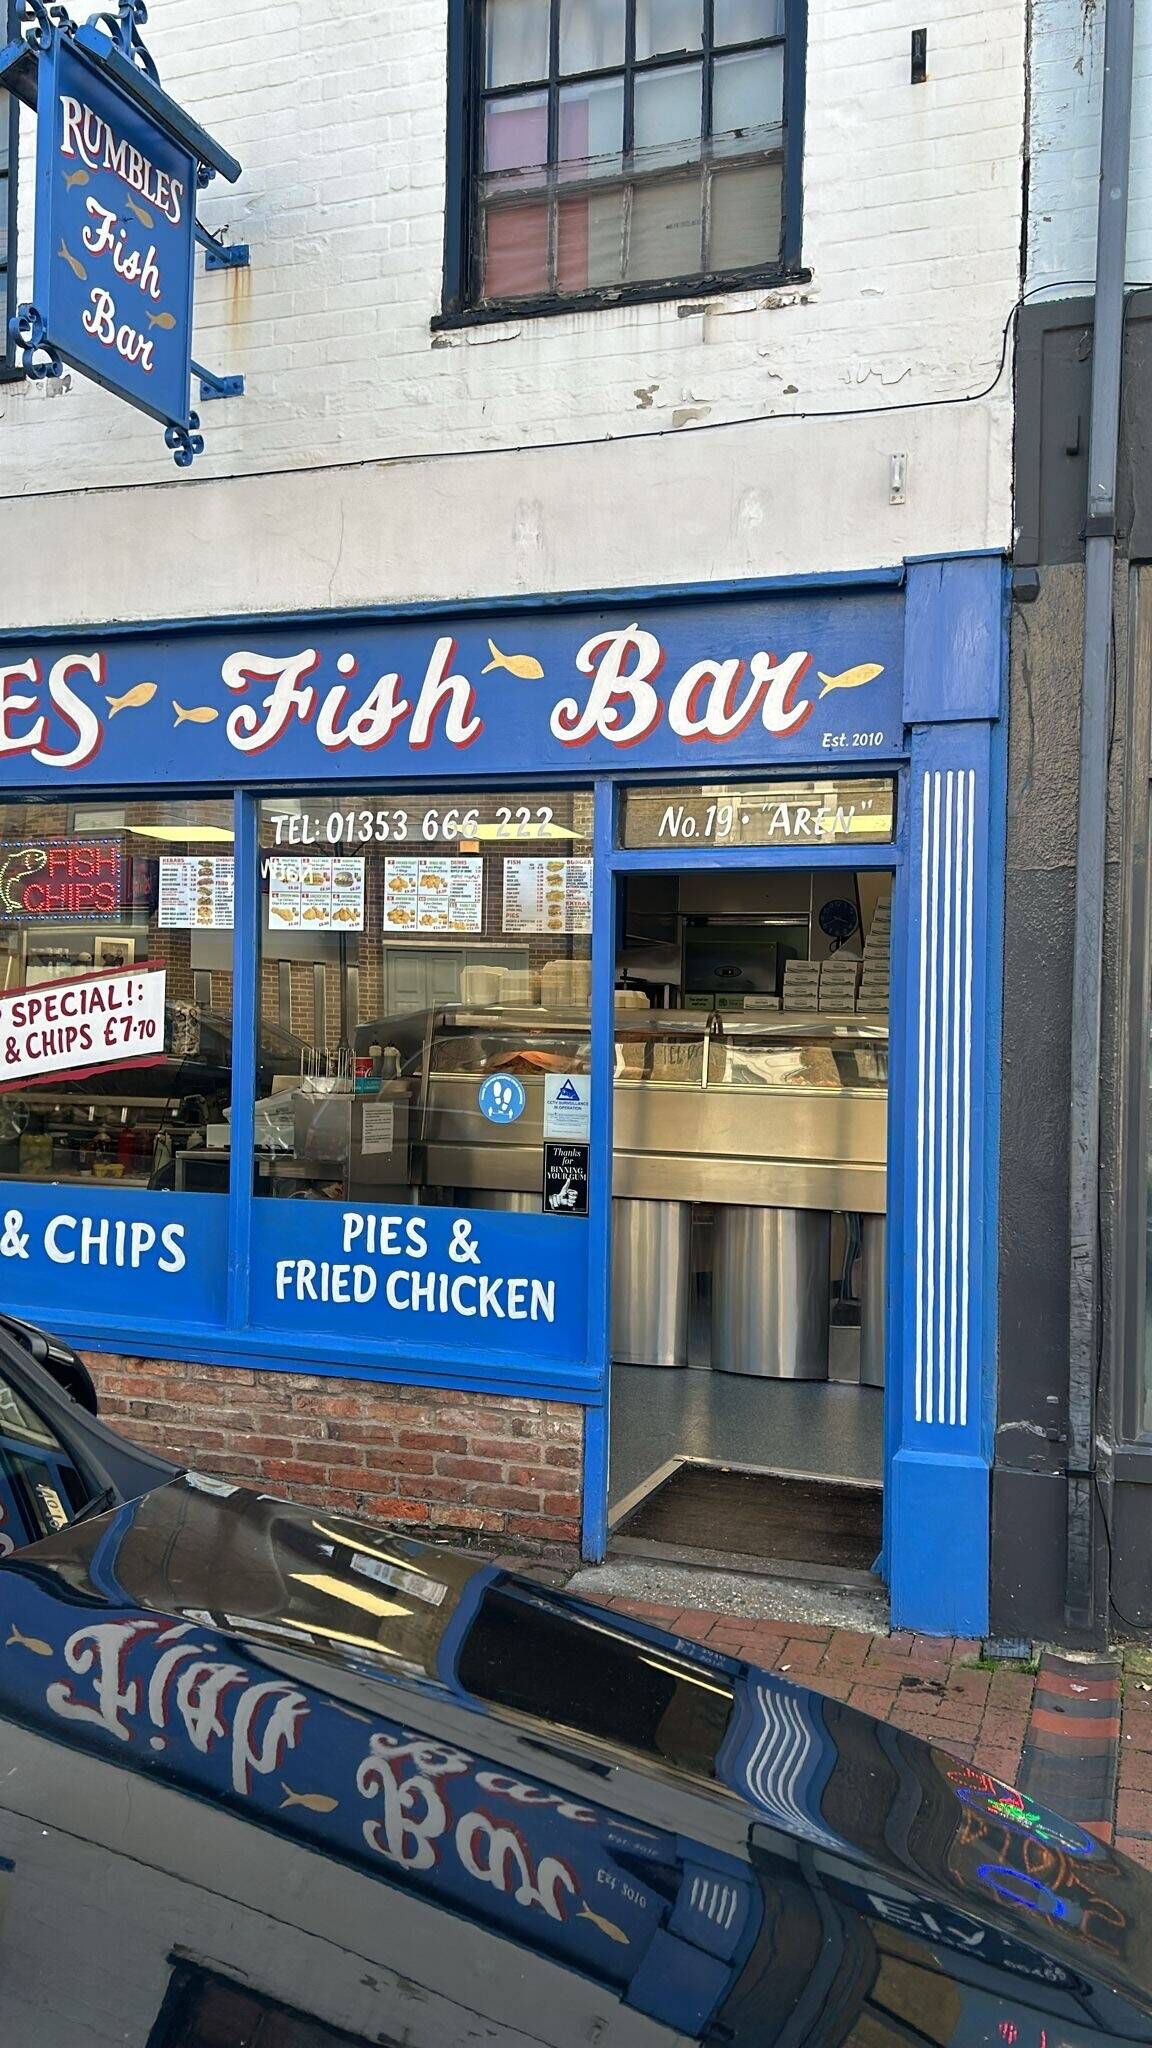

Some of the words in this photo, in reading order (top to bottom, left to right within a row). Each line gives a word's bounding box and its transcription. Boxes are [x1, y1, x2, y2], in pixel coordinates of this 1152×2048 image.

[60, 95, 183, 224] RUMBLES
[82, 196, 161, 299] Fish
[82, 287, 154, 372] Bar
[221, 636, 482, 753] Fish
[550, 623, 813, 747] Bar
[822, 732, 849, 748] Est.
[852, 731, 884, 746] 2010
[422, 808, 480, 841] 666
[495, 805, 554, 838] 222
[49, 847, 116, 878] FISH
[22, 882, 115, 912] CHIPS
[5, 1036, 22, 1064] &
[26, 1023, 93, 1059] CHIPS
[550, 1165, 584, 1174] BINNING
[553, 1147, 582, 1157] Thanks
[562, 1156, 574, 1166] for
[547, 1172, 568, 1180] YOUR
[569, 1173, 587, 1181] GUM
[0, 1209, 30, 1259] &
[44, 1214, 187, 1273] CHIPS
[342, 1212, 428, 1258] PIES
[448, 1218, 482, 1264] &
[276, 1259, 378, 1303] FRIED
[386, 1270, 556, 1323] CHICKEN
